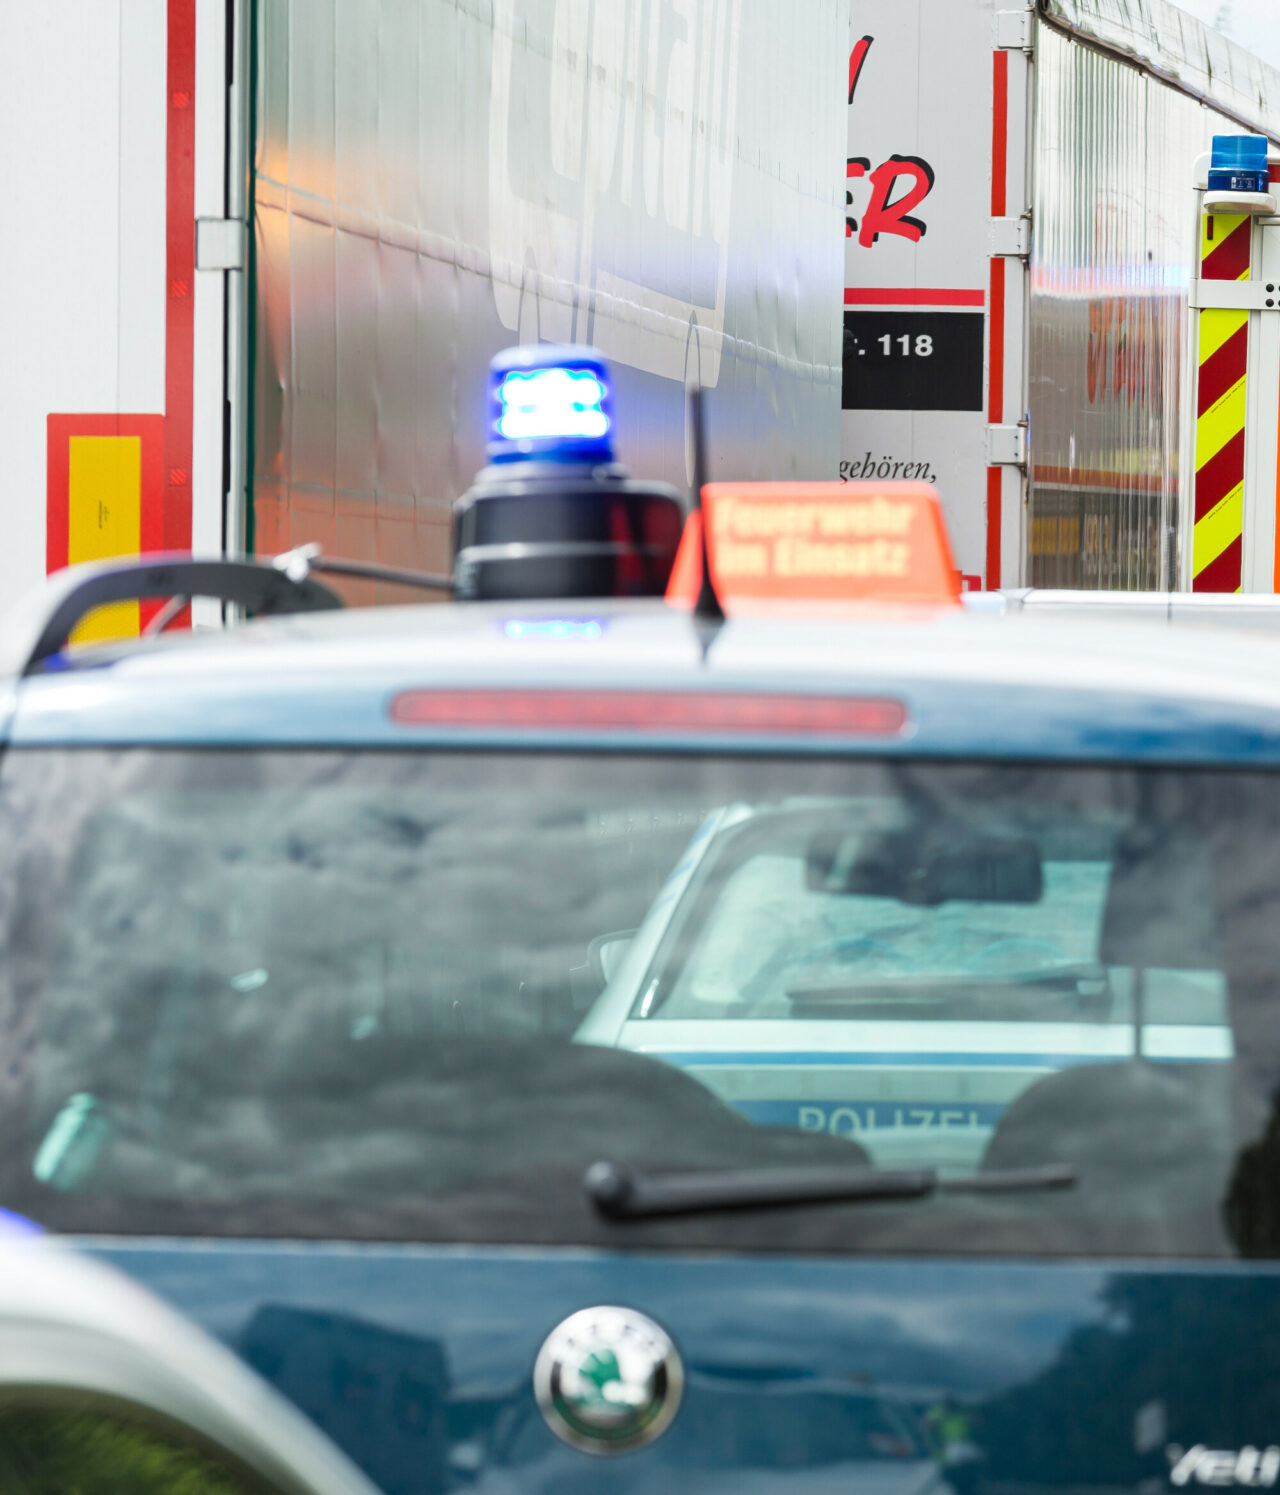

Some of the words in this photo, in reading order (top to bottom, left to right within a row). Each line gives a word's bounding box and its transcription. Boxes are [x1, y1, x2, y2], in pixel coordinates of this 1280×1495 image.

[877, 334, 934, 357] 118
[839, 452, 937, 485] gehören,
[714, 498, 912, 539] Feuerwehr
[774, 537, 909, 576] Einsatz
